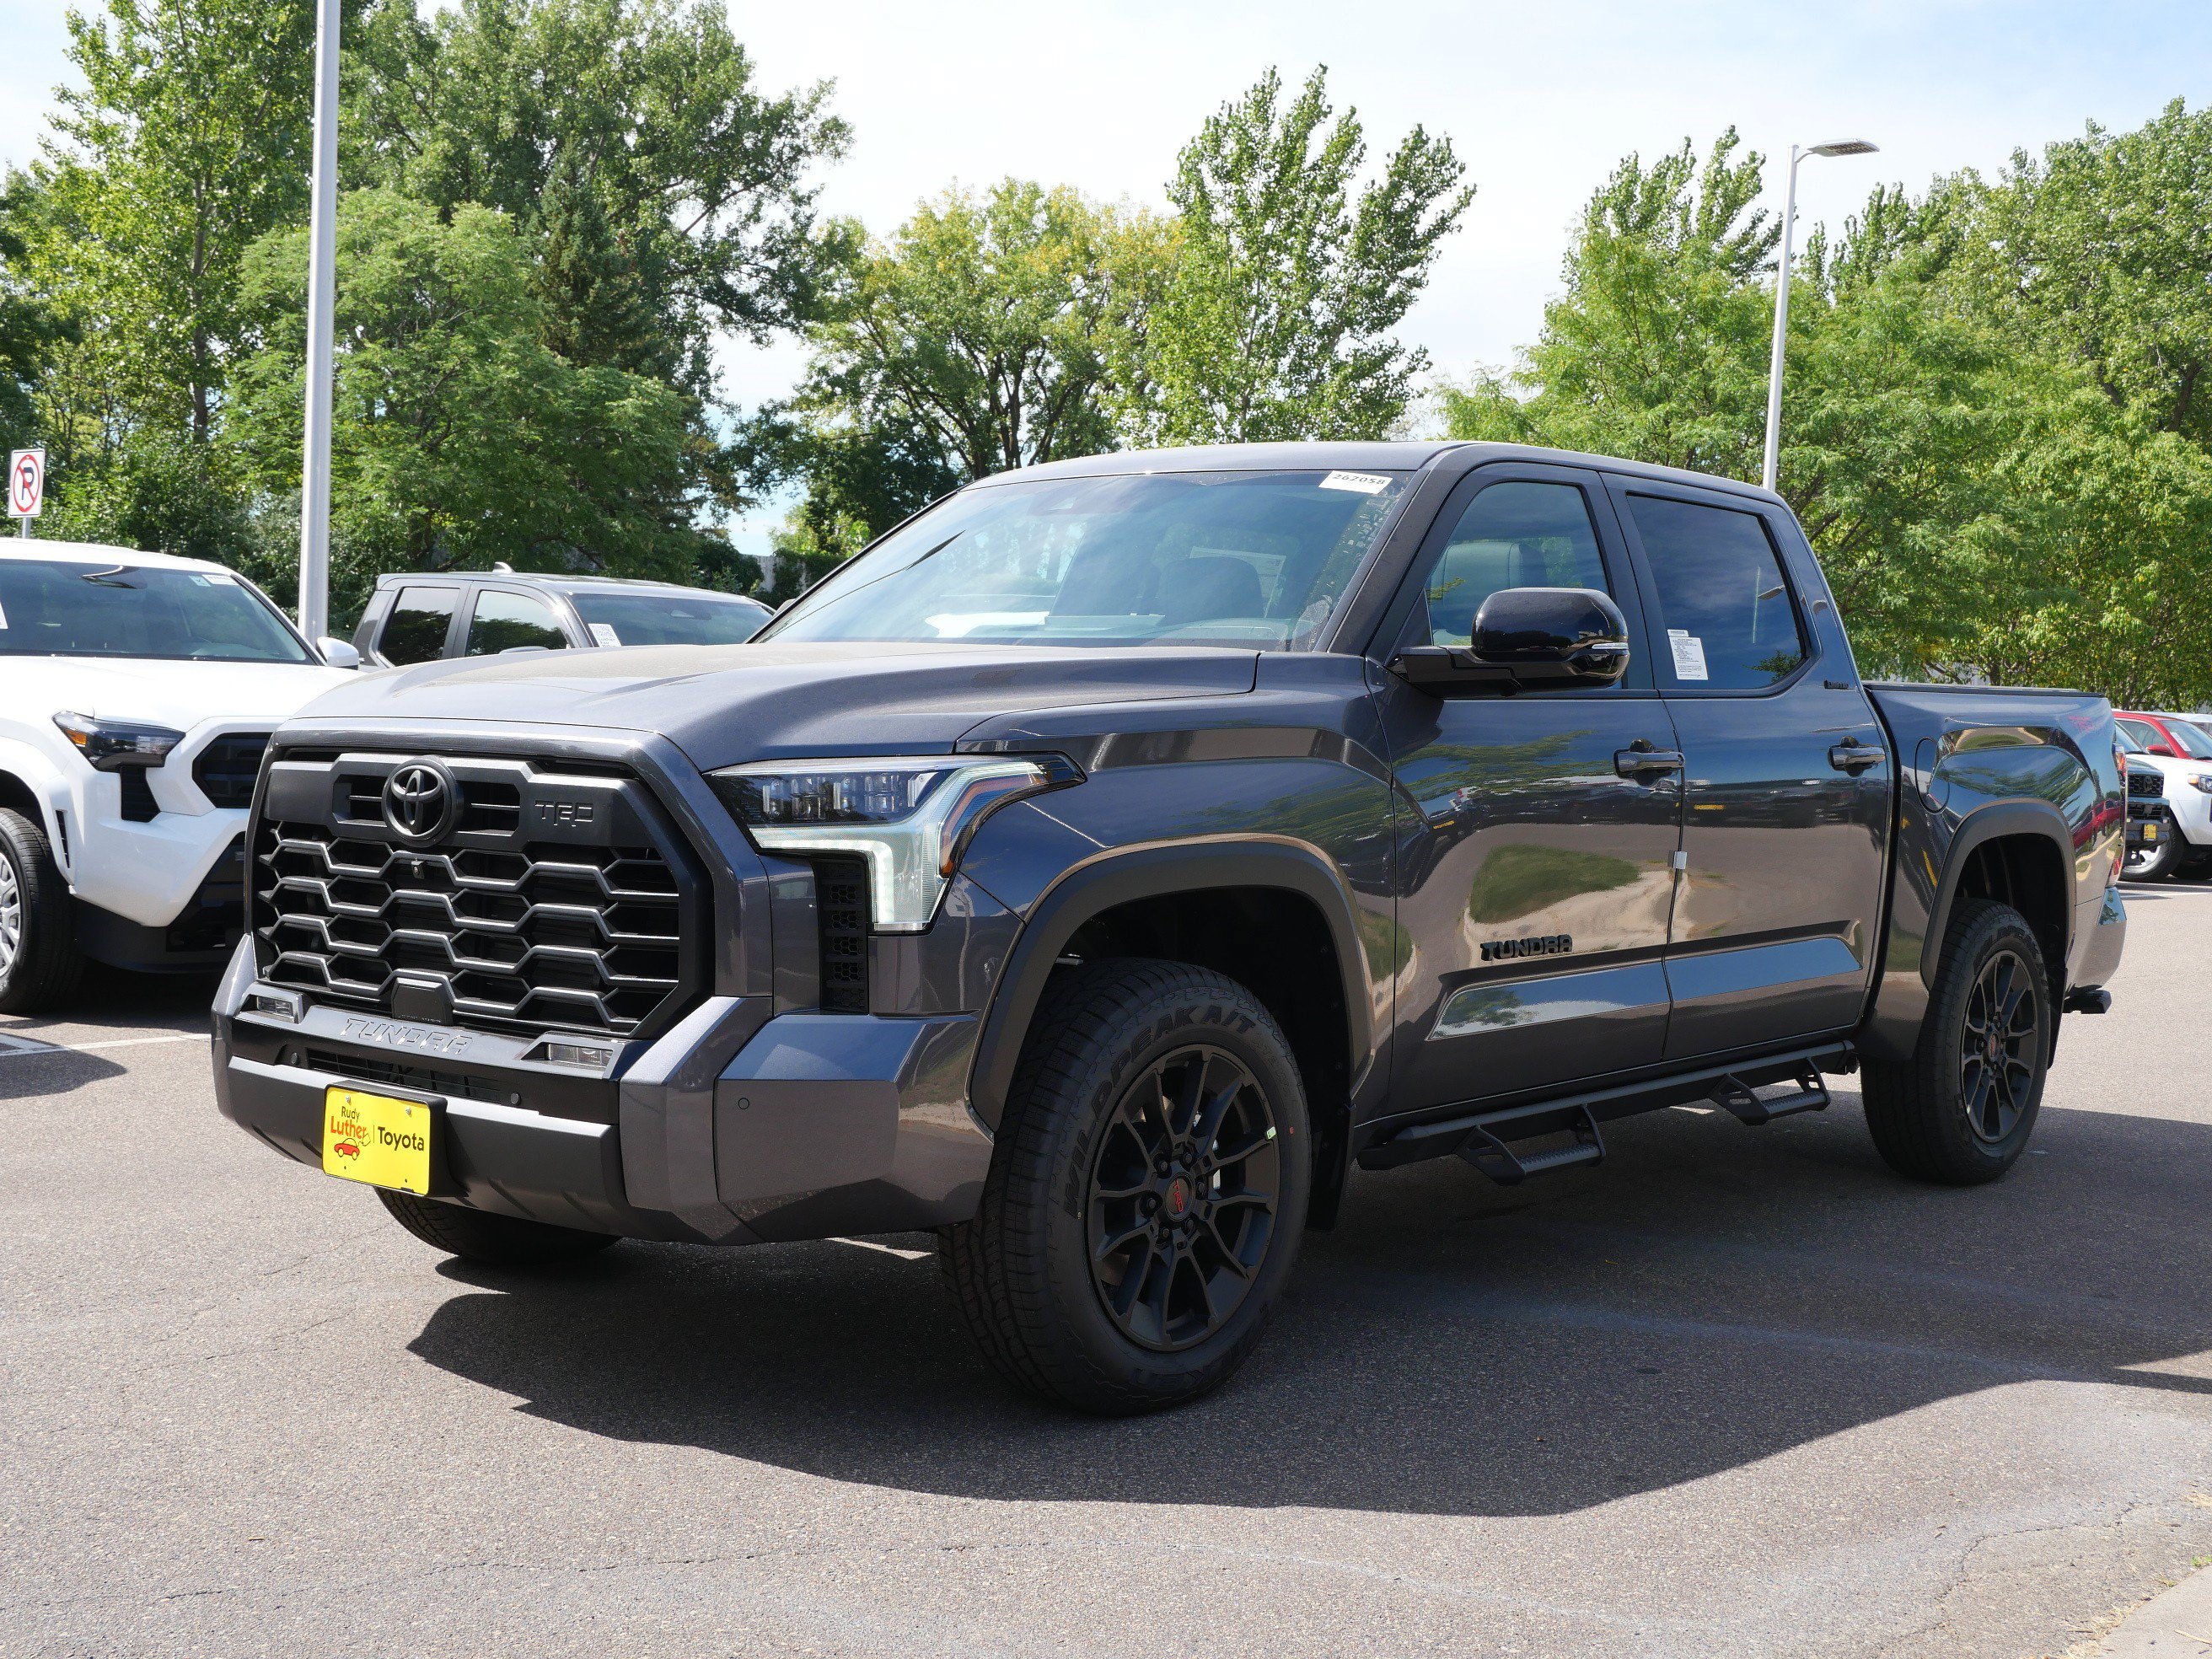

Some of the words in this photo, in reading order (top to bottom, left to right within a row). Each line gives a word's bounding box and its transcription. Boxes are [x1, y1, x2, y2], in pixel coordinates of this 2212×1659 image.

[534, 799, 594, 827] TRD
[1480, 933, 1572, 961] TUNDRA
[340, 1017, 474, 1055] TUNDRA
[341, 1106, 361, 1123] Rudy
[1065, 1006, 1196, 1219] WILDPEAK
[1200, 1005, 1256, 1034] A/T
[330, 1115, 368, 1140] Luther
[377, 1125, 425, 1152] Toyota
